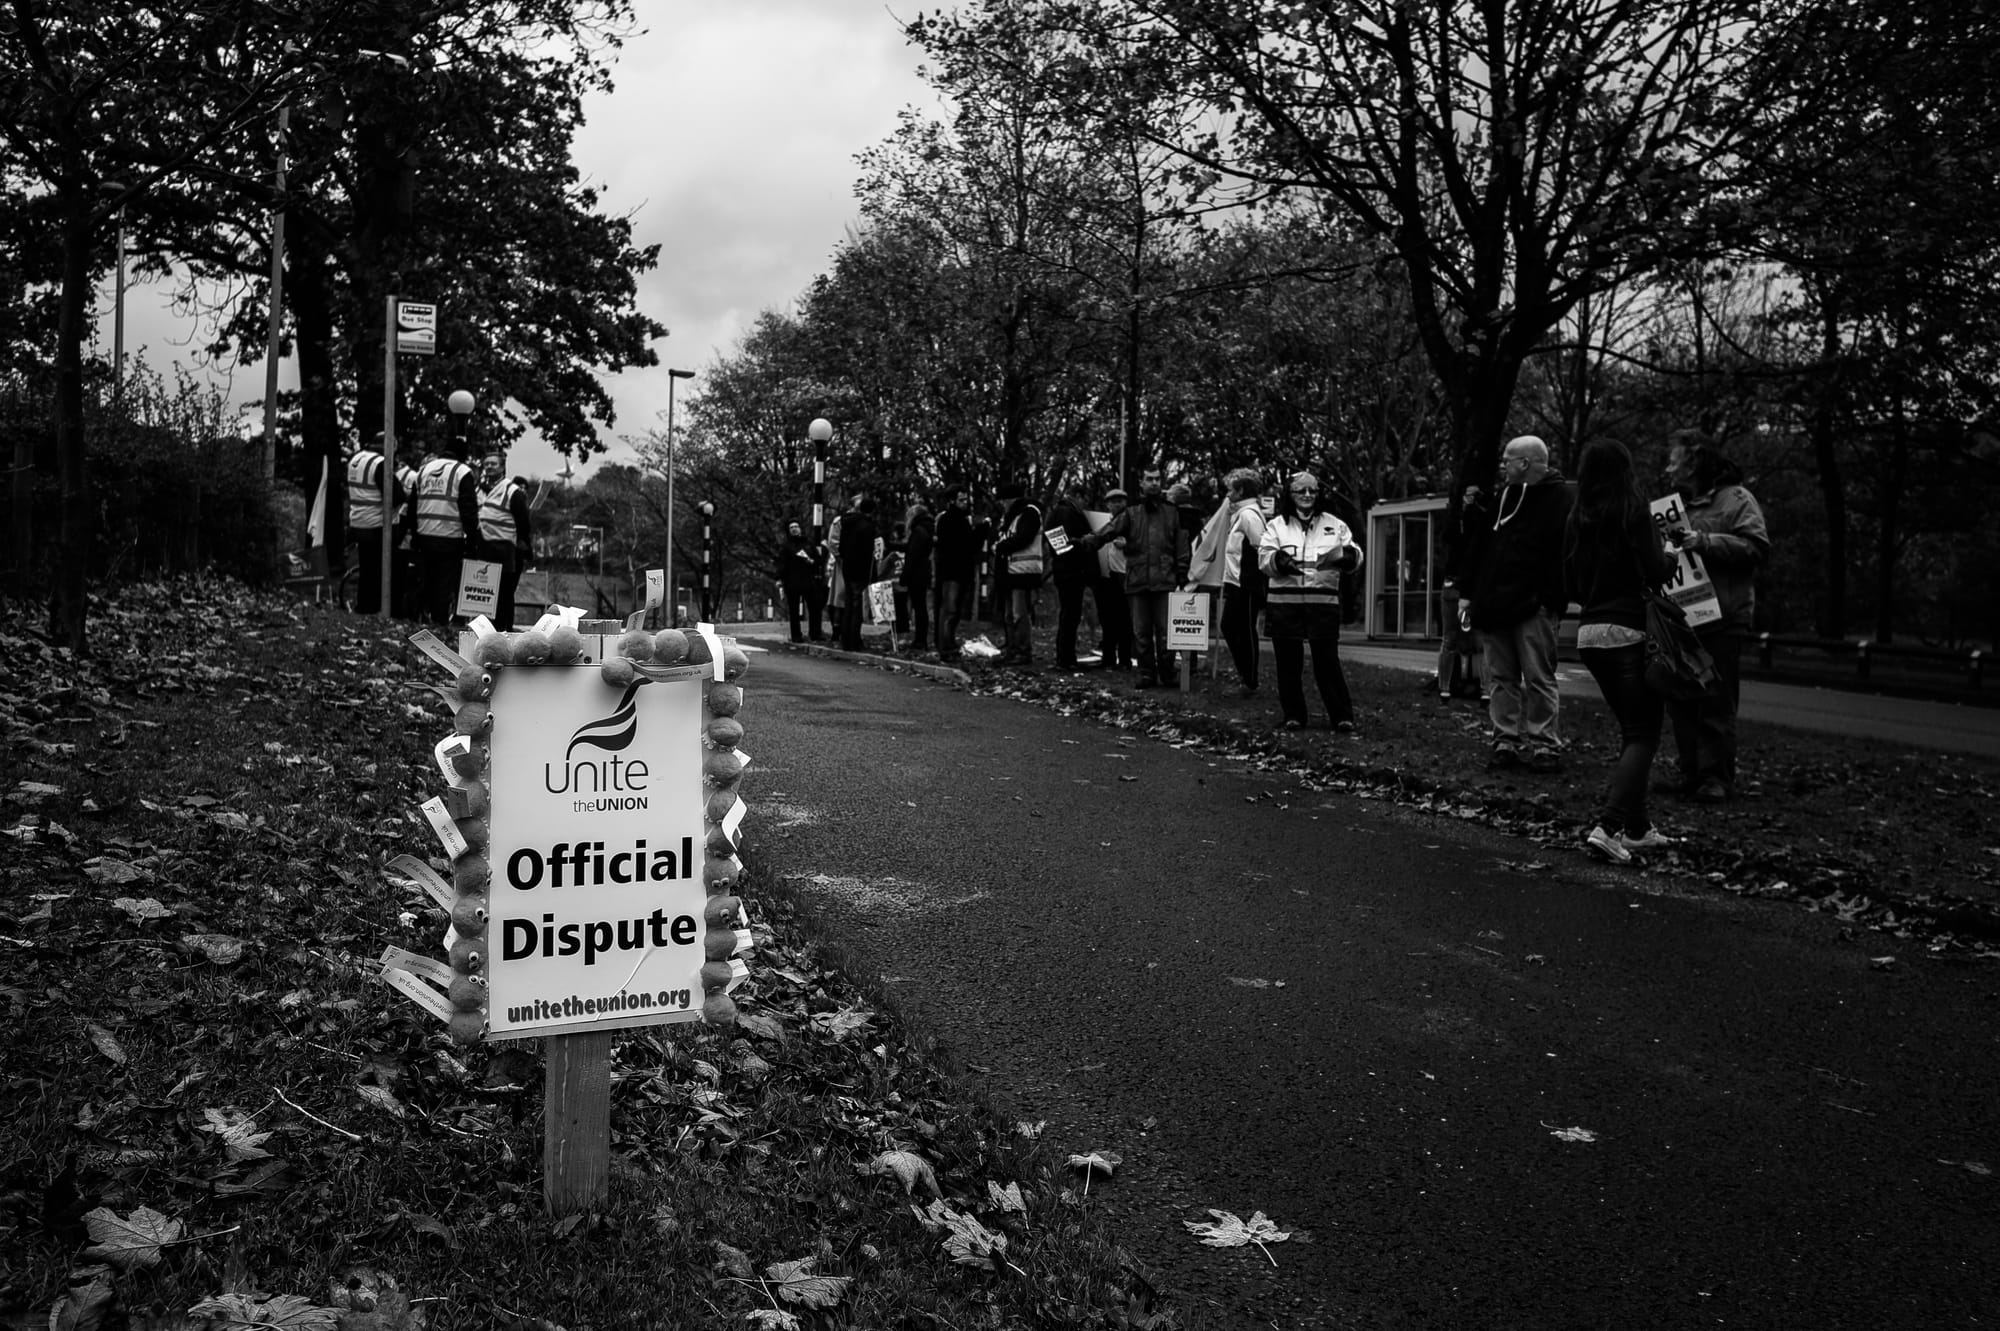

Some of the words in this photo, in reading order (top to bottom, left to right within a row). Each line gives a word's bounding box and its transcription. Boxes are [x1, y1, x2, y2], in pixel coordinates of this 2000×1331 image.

[464, 585, 495, 596] OFFICIAL
[466, 594, 492, 603] PICKET
[545, 754, 649, 794] unite
[506, 836, 693, 891] Official
[502, 908, 697, 966] Dispute
[507, 988, 691, 1023] unitetheunion.org
